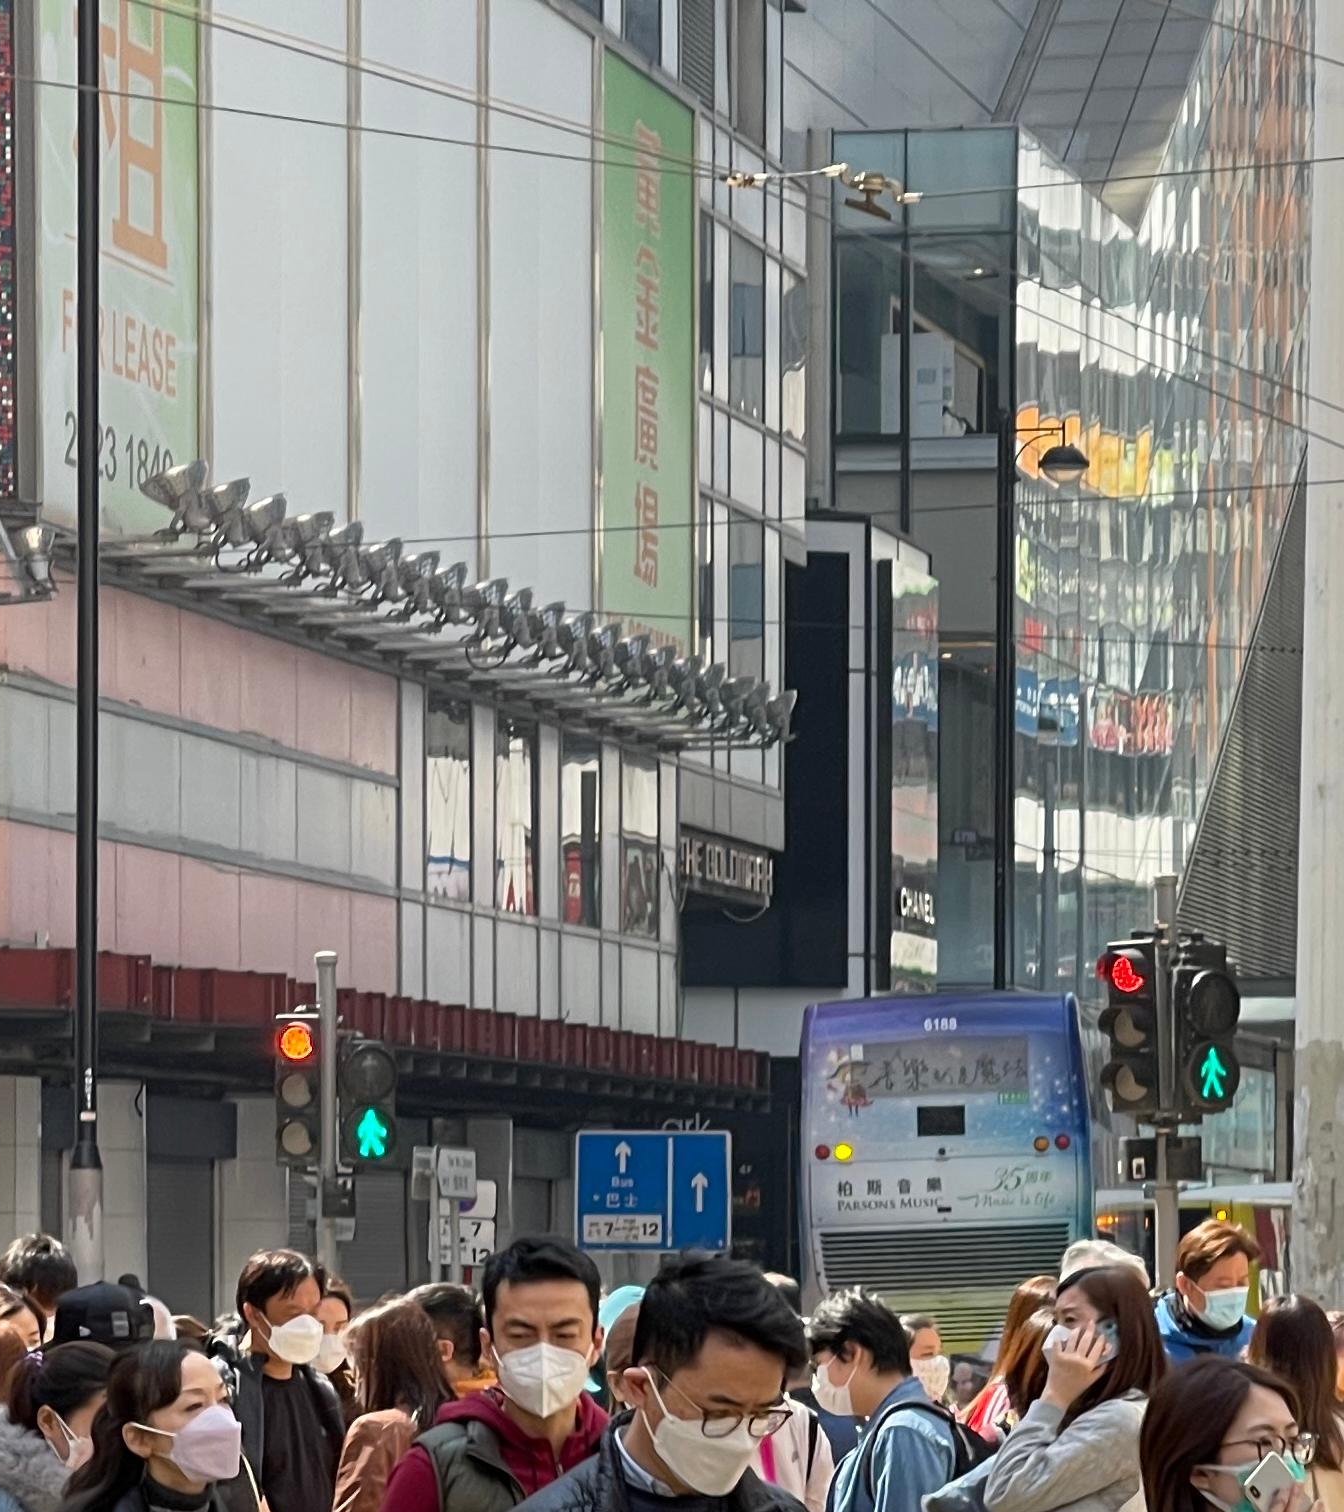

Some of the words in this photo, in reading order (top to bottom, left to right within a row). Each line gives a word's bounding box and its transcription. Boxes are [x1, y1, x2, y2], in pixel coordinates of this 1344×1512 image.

[112, 310, 176, 398] LEASE
[900, 887, 935, 924] CHANEL
[923, 1016, 957, 1031] 6188
[611, 1176, 634, 1188] Bus
[838, 1176, 942, 1198] 柏斯音樂
[606, 1192, 639, 1208] 巴士
[837, 1197, 896, 1212] PARSONS
[900, 1195, 943, 1210] MUSIC
[471, 1221, 482, 1237] 7
[604, 1221, 614, 1236] 7
[641, 1222, 659, 1237] 12
[471, 1247, 491, 1263] 12
